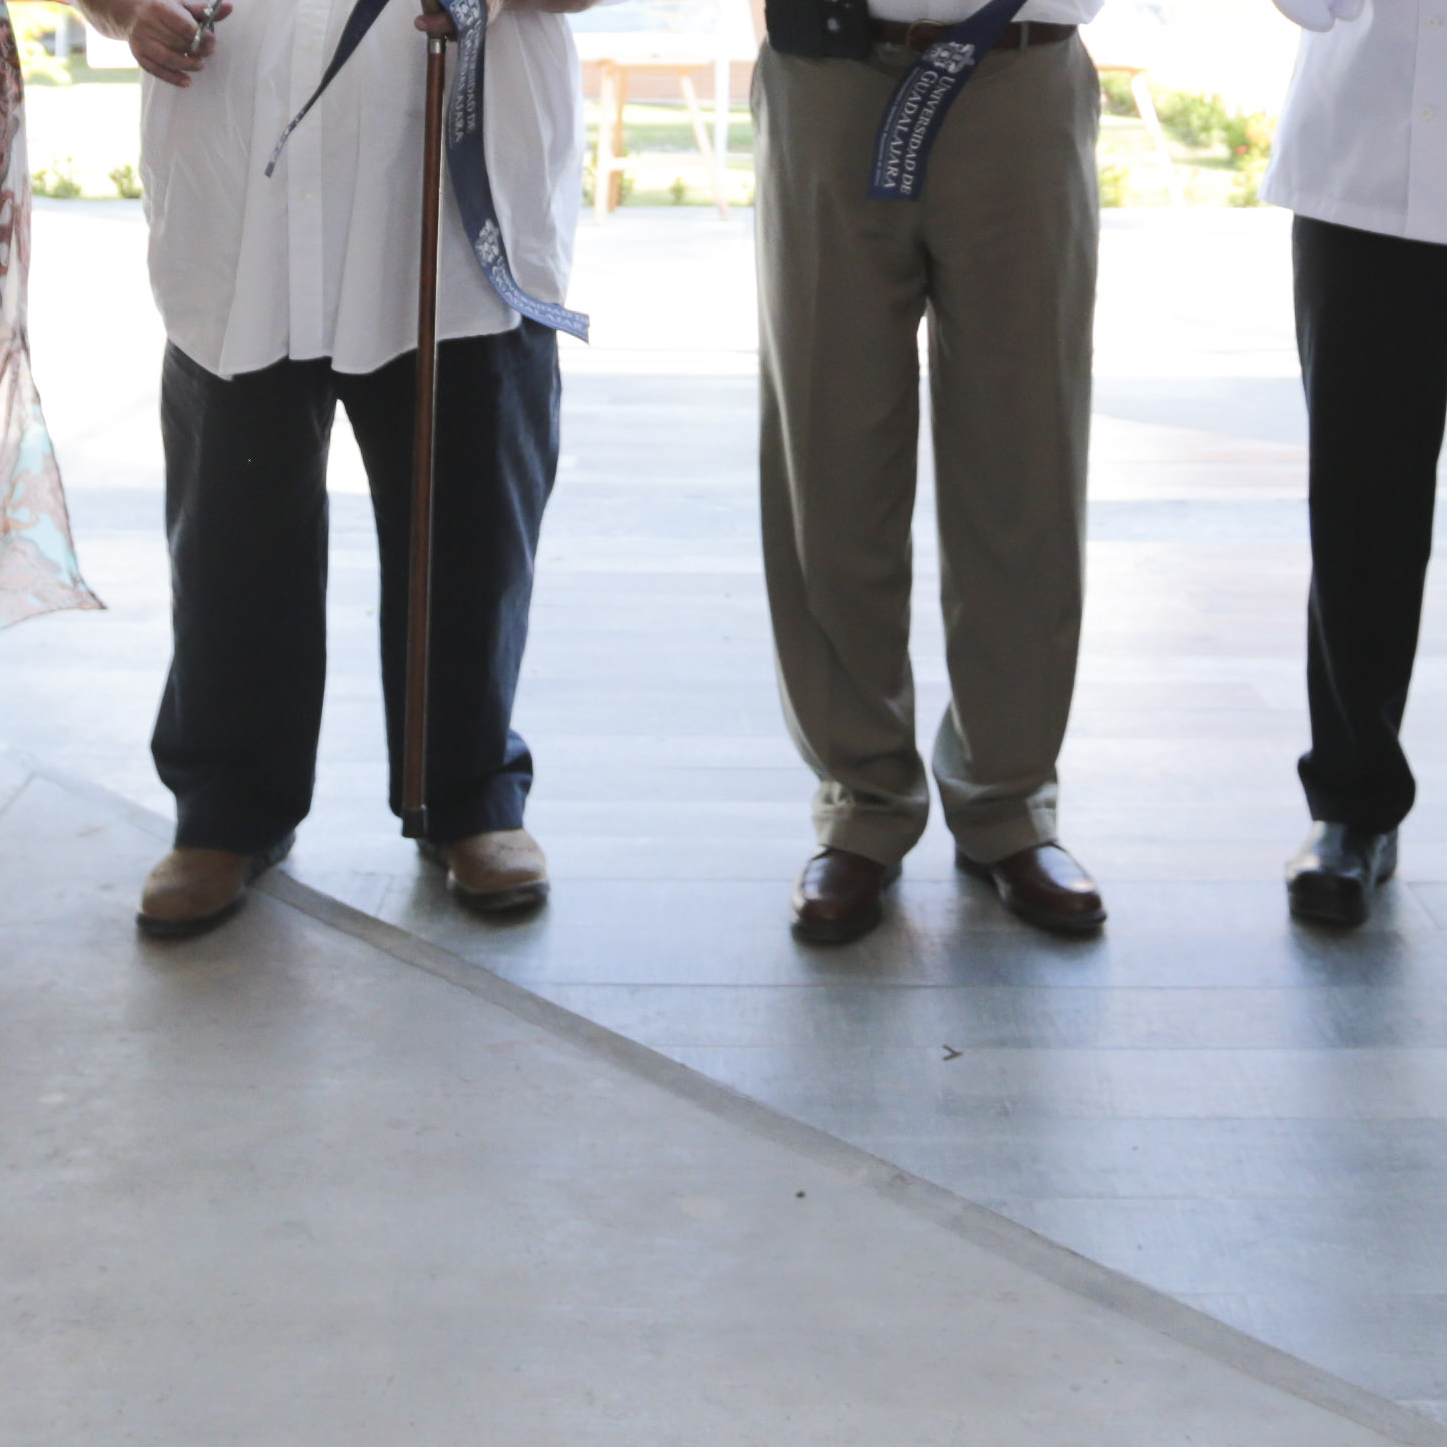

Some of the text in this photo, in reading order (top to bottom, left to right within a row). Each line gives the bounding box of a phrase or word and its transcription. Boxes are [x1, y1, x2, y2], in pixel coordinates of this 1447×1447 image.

[884, 69, 938, 188] GUADALAJARA
[900, 75, 955, 195] UNIVERSIDAD DE
